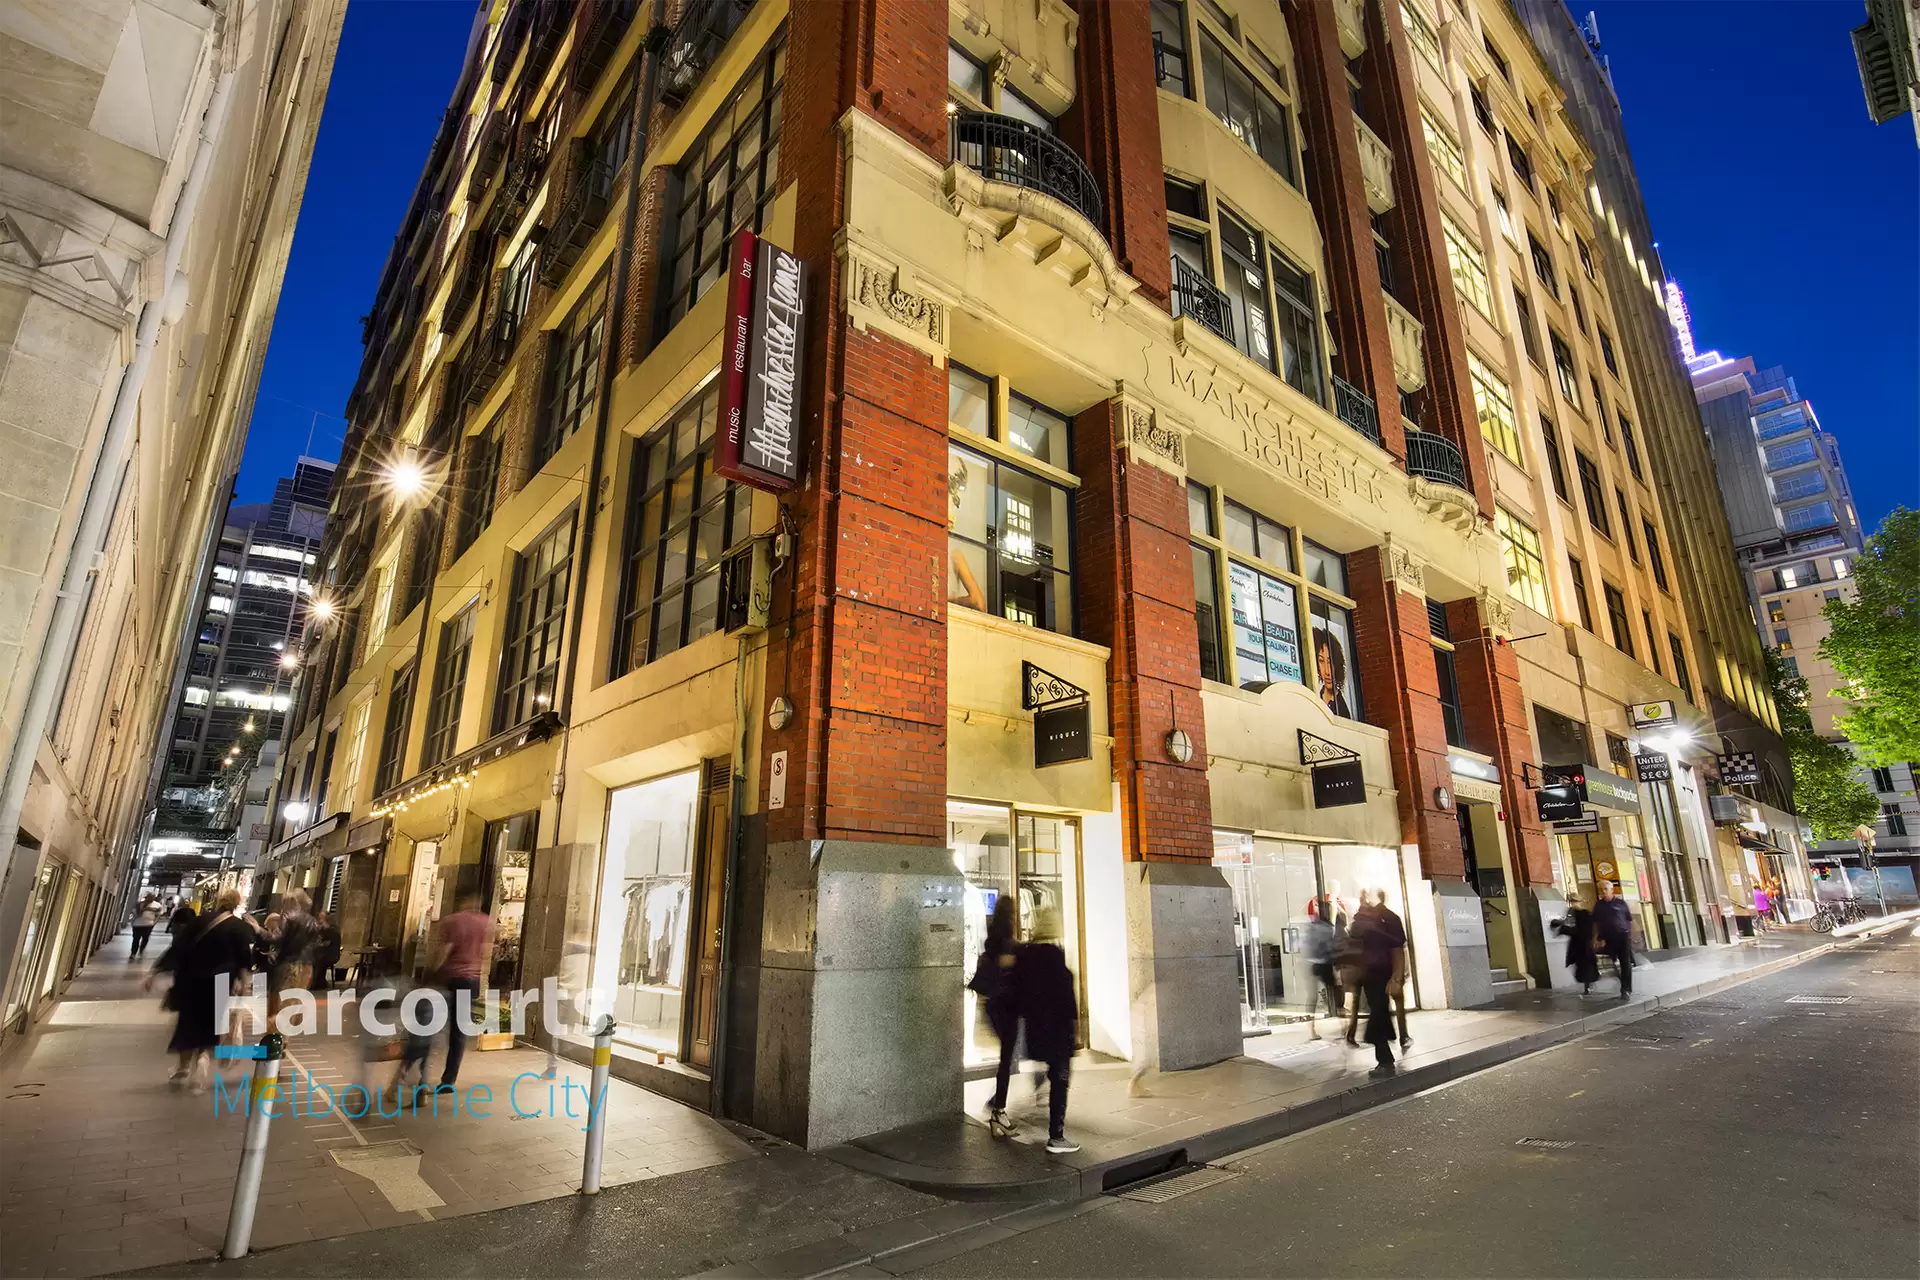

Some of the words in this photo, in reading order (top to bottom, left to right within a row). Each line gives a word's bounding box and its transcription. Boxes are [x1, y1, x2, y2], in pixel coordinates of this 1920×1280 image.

[740, 258, 752, 279] bar
[766, 250, 803, 315] Lane
[735, 315, 748, 373] restaurant
[749, 309, 796, 473] Manchester
[728, 407, 741, 444] music
[1169, 355, 1388, 513] MANCHESTER
[1242, 429, 1342, 503] HOUSE
[1265, 624, 1295, 643] BEAUTY
[1269, 661, 1292, 677] CHASE
[1724, 774, 1757, 782] Police
